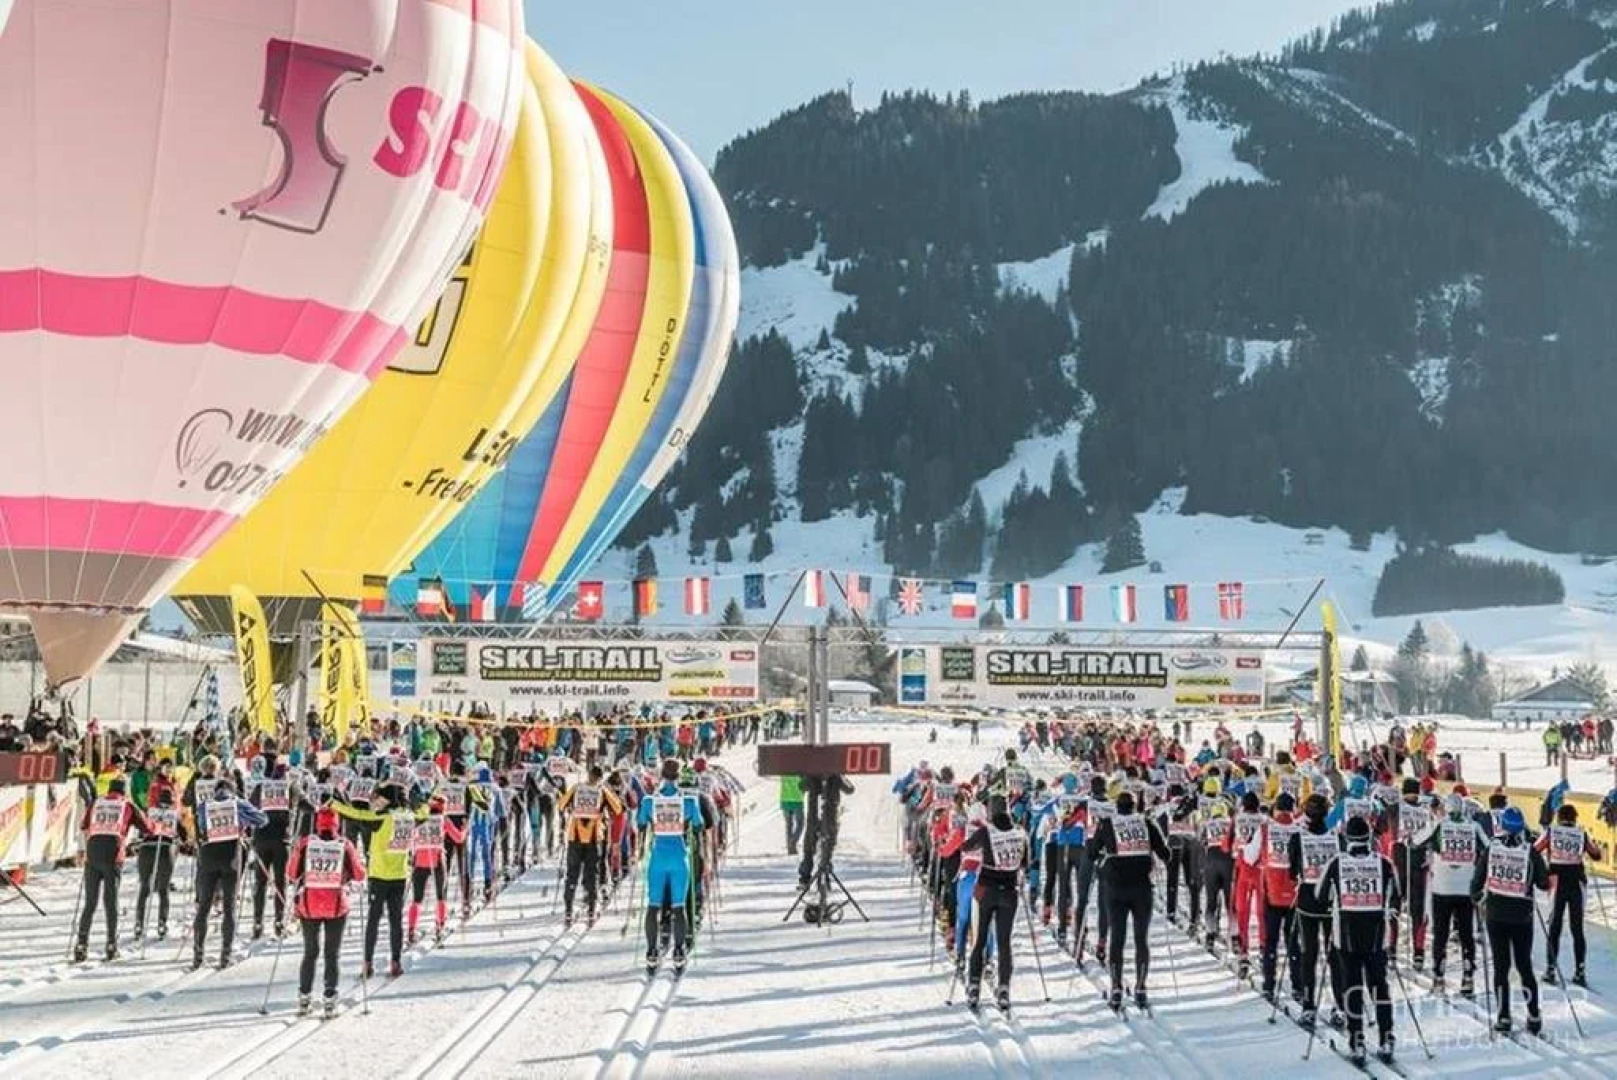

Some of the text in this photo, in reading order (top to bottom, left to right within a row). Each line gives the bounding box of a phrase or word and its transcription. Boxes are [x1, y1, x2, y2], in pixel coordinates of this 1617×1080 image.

[481, 646, 662, 670] SKI-TRAIL
[987, 651, 1167, 676] SKI-TRAIL
[509, 684, 630, 696] www.ski-trail.info
[1017, 690, 1136, 701] www.ski-trail.info
[20, 754, 56, 781] 00
[847, 747, 881, 771] 00
[1492, 865, 1524, 881] 1305
[1344, 879, 1377, 894] 1351
